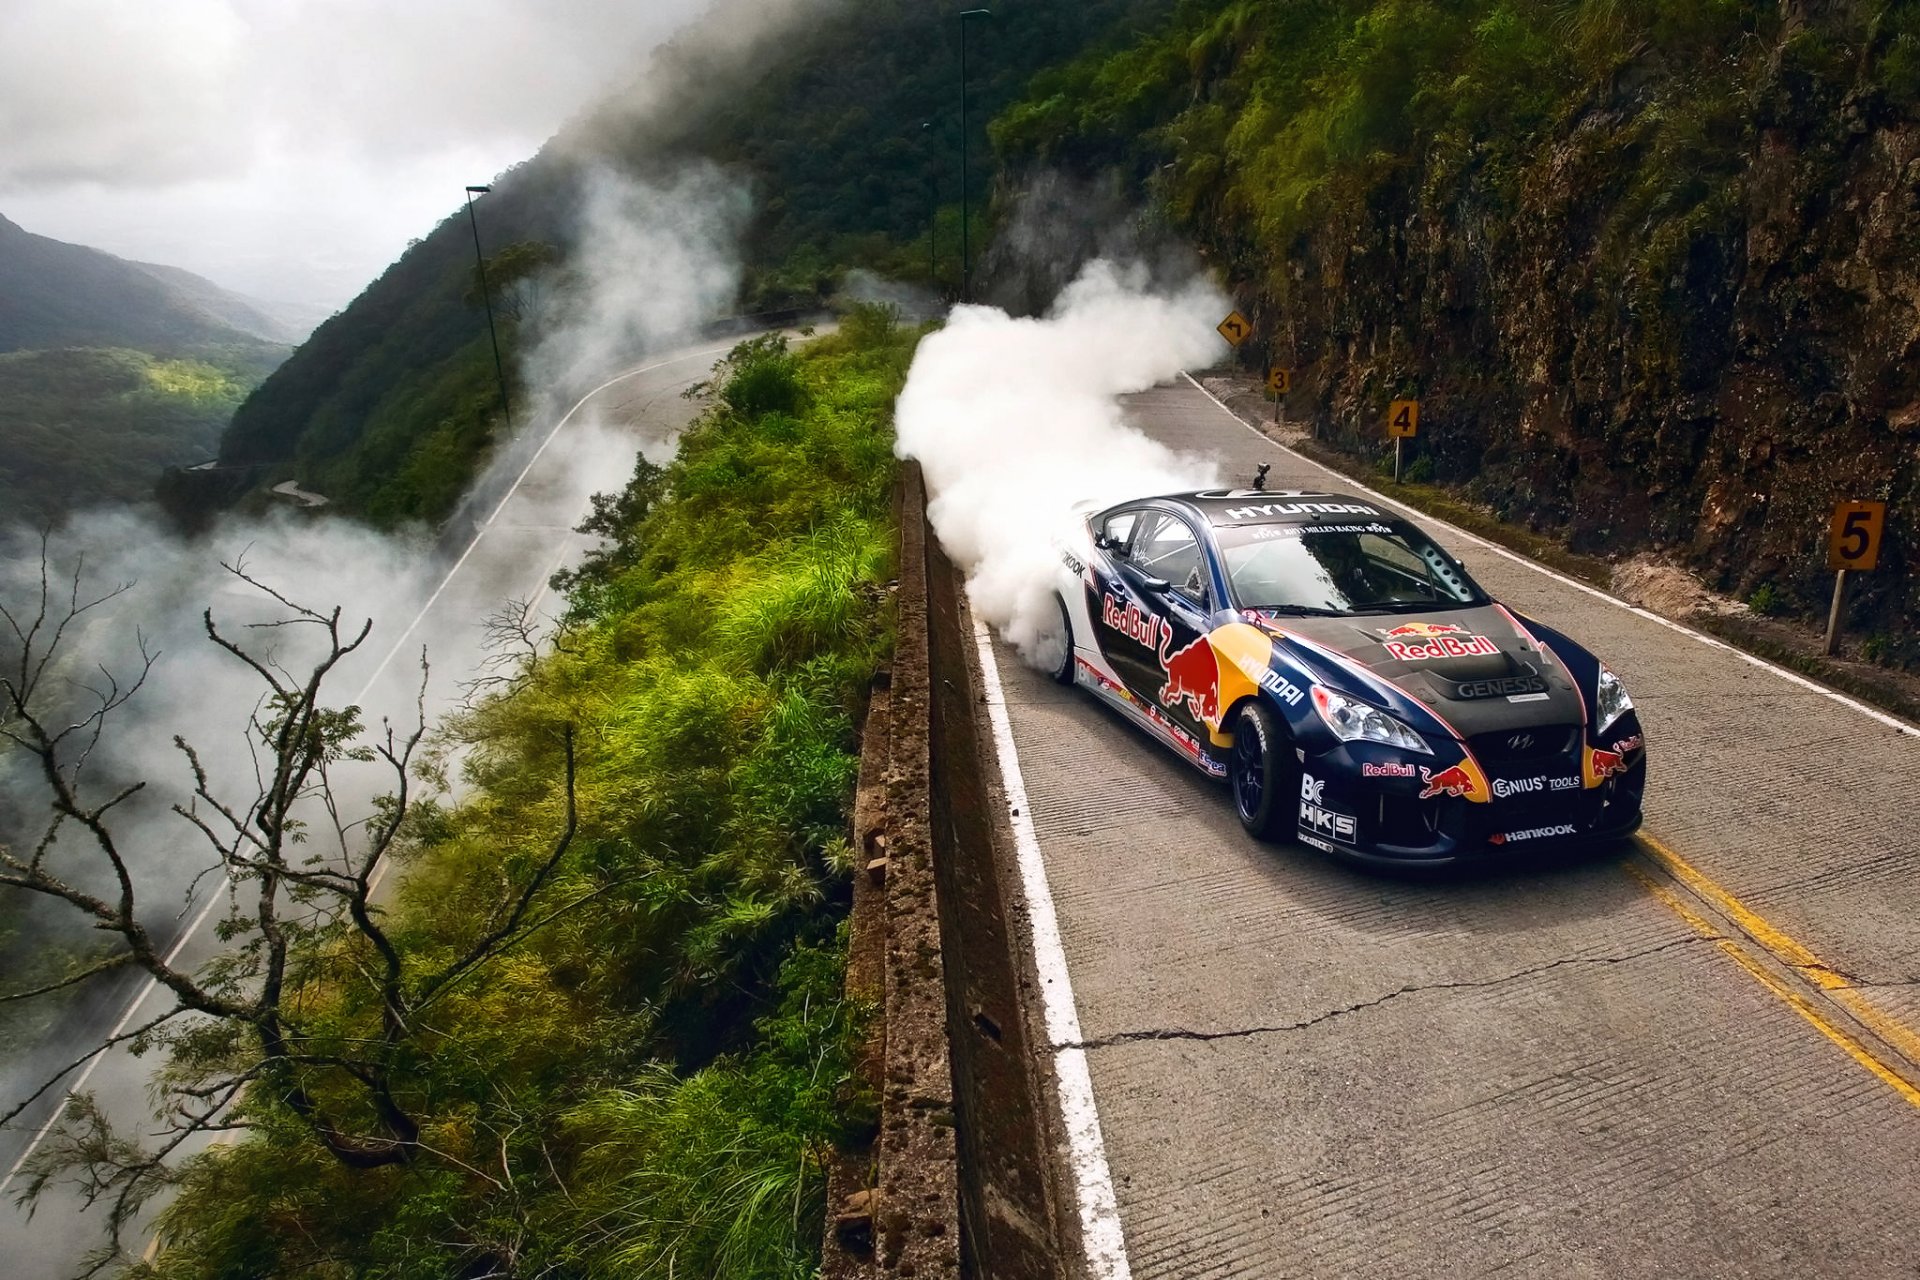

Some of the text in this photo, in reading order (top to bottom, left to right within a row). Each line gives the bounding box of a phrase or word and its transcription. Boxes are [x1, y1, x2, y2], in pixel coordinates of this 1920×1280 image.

[1274, 371, 1285, 389] 3
[1394, 406, 1411, 432] 4
[1225, 503, 1380, 520] HYUNDAI
[1840, 511, 1872, 560] 5
[1103, 592, 1161, 651] Red Bull
[1383, 635, 1501, 661] Red Bull
[1239, 653, 1305, 707] HYUNDAI
[1458, 680, 1544, 698] GENESIS
[1362, 763, 1416, 777] Red Bull
[1549, 776, 1580, 789] TOOLS
[1300, 802, 1354, 836] HKS
